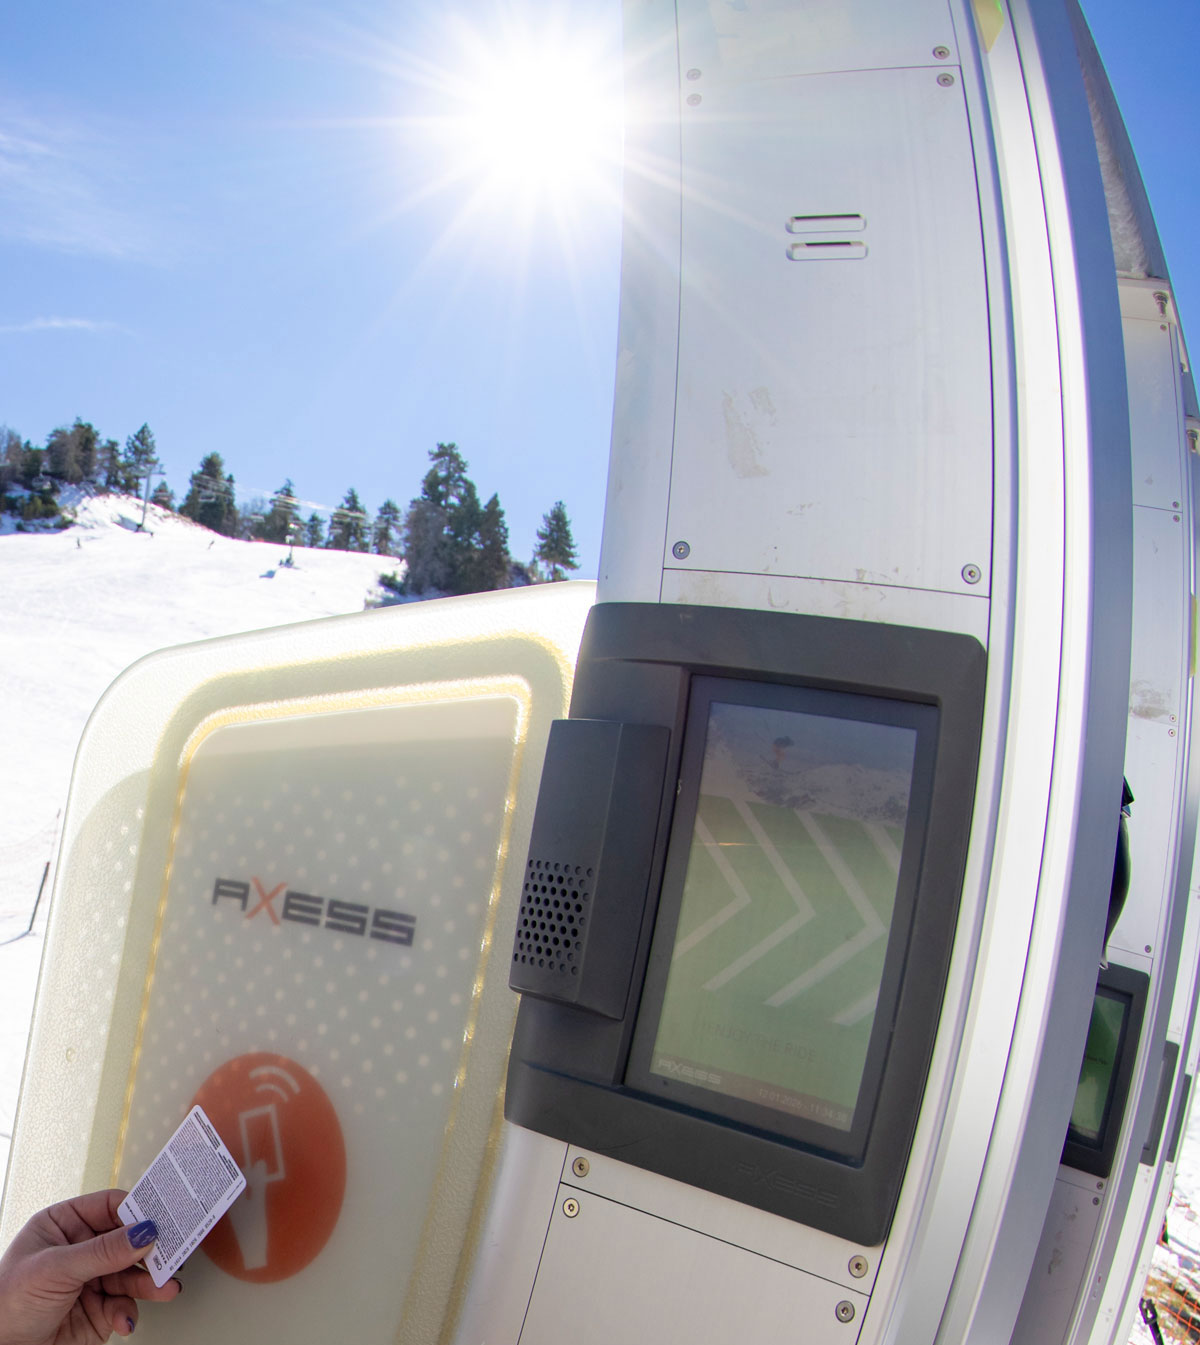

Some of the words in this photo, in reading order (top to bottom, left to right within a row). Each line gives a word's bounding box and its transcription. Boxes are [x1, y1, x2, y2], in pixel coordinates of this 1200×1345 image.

[211, 876, 417, 948] AXESS
[783, 1042, 817, 1063] RIDE
[658, 1060, 722, 1085] AXESS
